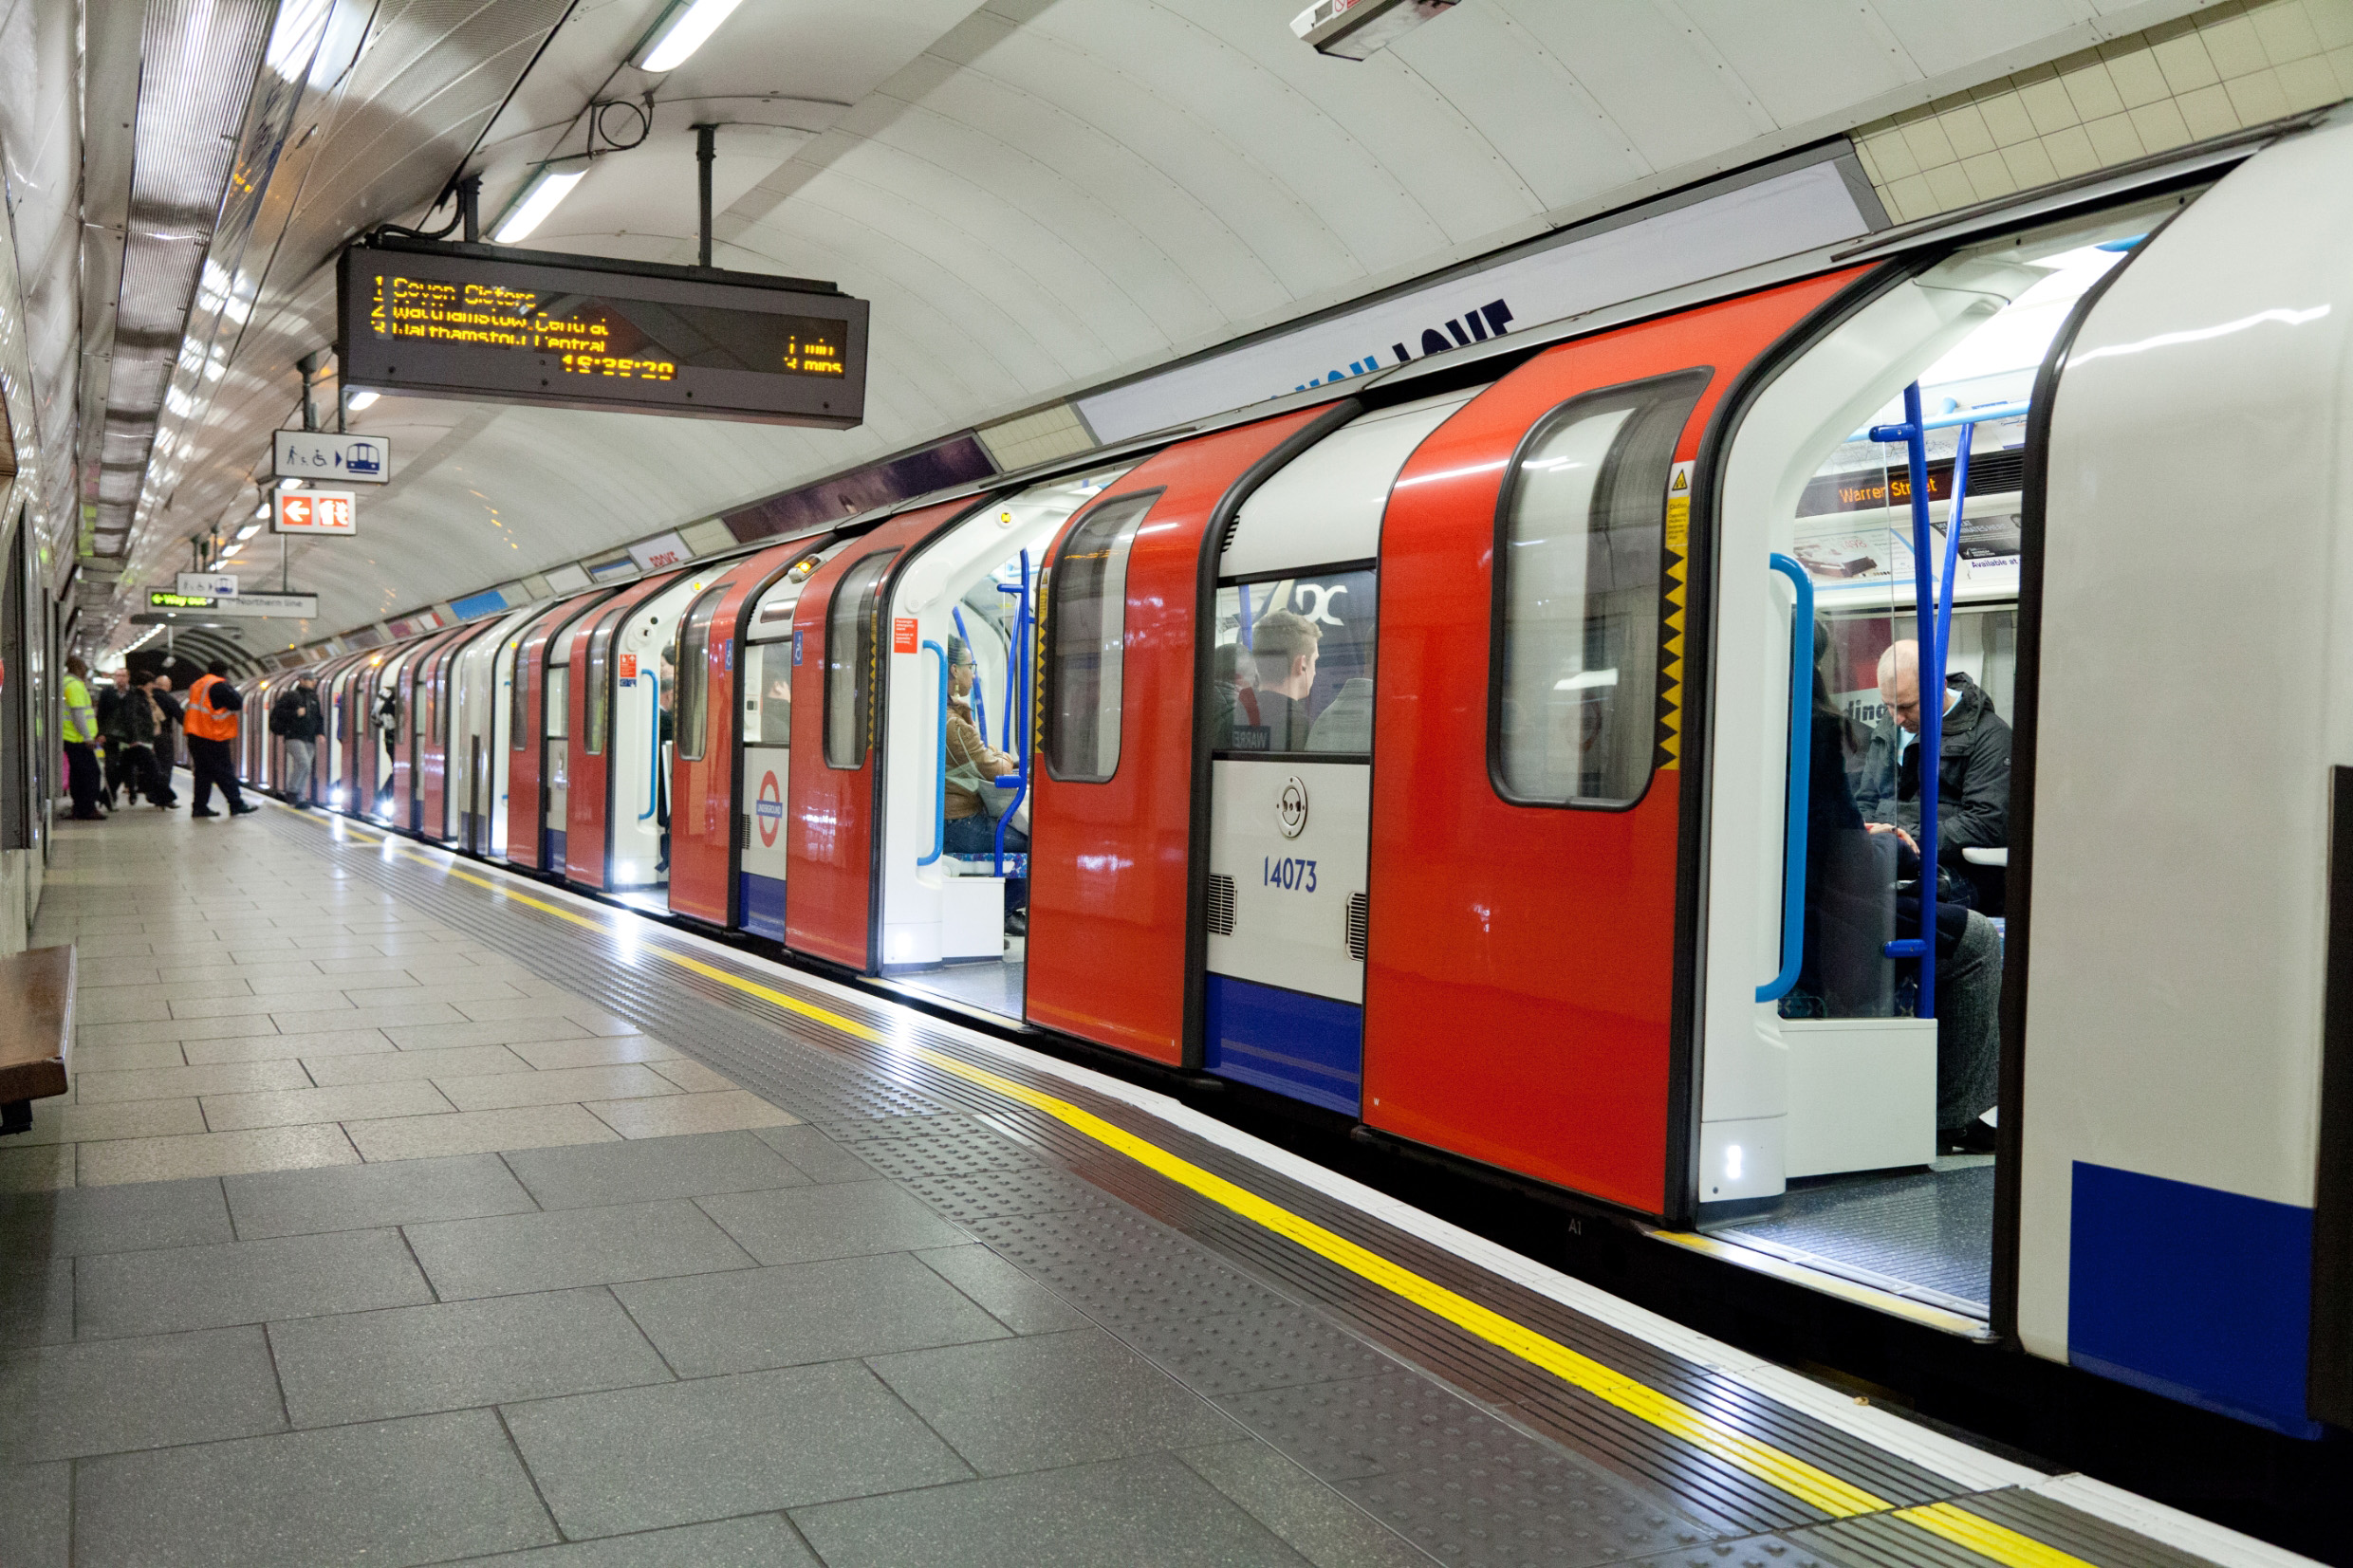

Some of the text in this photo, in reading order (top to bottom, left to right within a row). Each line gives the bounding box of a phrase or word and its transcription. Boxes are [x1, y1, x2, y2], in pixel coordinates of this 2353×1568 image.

[392, 323, 527, 346] Walthamstow
[534, 335, 606, 353] Central
[804, 360, 843, 374] mins
[805, 338, 835, 356] min
[1839, 477, 1937, 504] Warren Strt
[1972, 558, 2008, 568] Available
[163, 594, 208, 607] Way out
[239, 598, 304, 608] Northern line
[1264, 856, 1318, 893] 14073
[1568, 1218, 1582, 1235] A1
